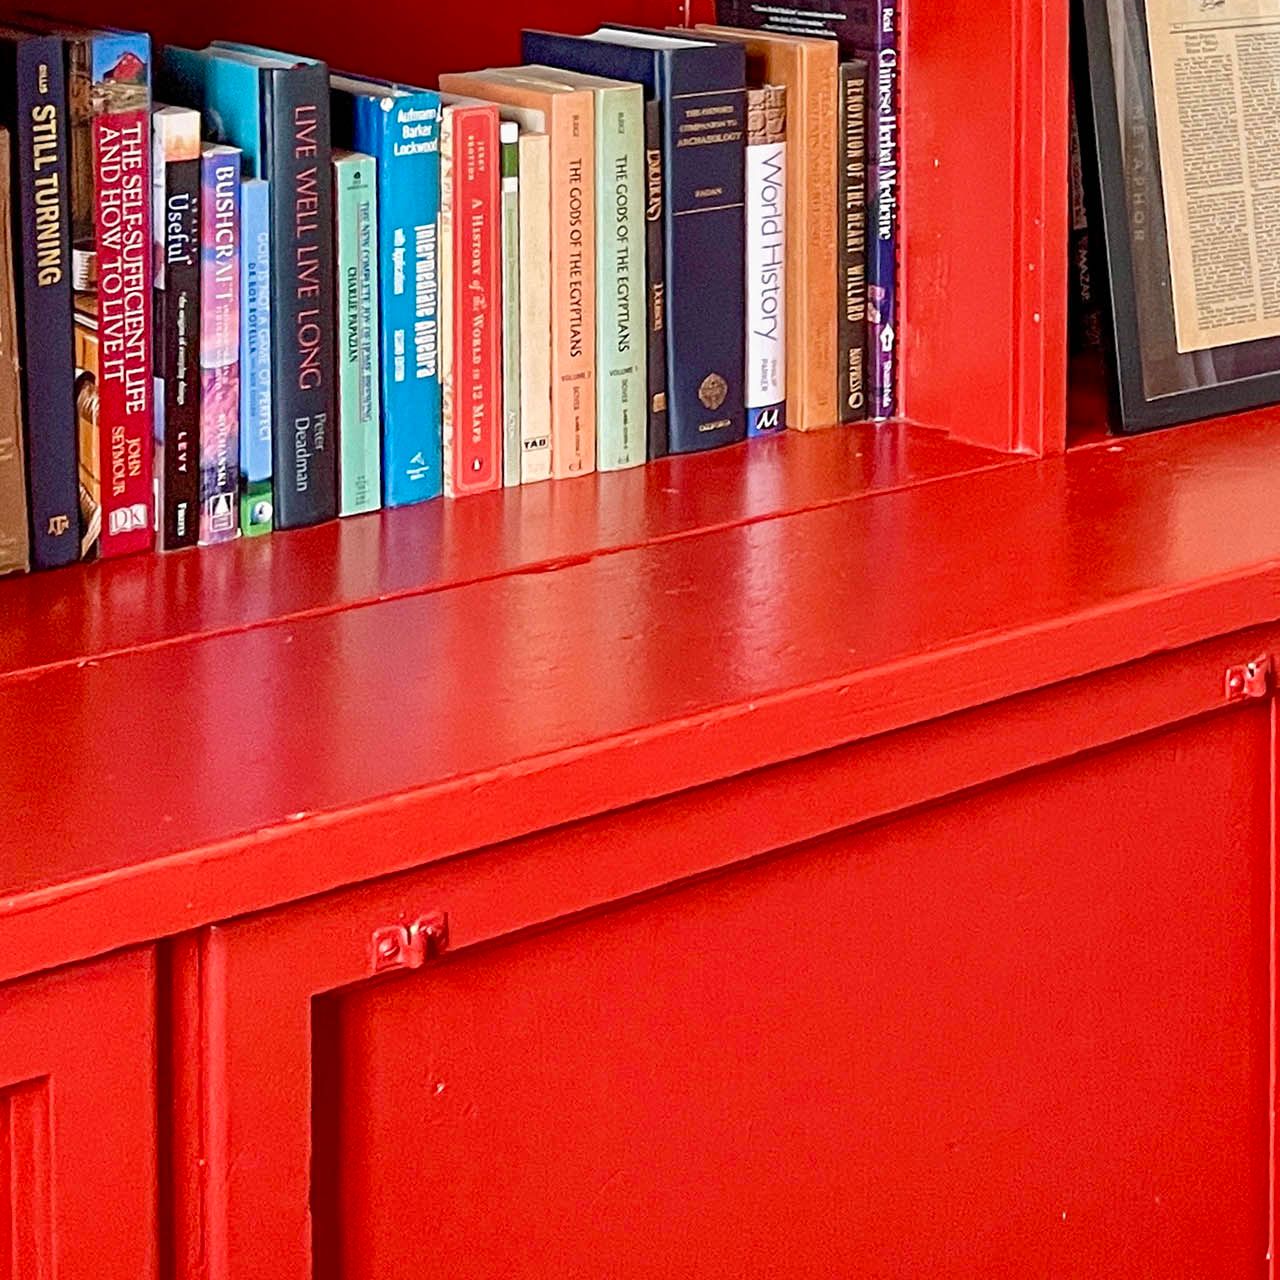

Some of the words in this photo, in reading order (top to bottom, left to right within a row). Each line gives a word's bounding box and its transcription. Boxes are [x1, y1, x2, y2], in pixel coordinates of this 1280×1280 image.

[32, 104, 56, 170] STILL
[99, 126, 122, 182] AND
[119, 122, 142, 170] THE
[294, 105, 317, 159] LIVE
[569, 157, 583, 185] THE
[615, 154, 629, 181] THE
[760, 150, 784, 236] World
[1133, 104, 1148, 242] METAPHOR
[35, 172, 61, 286] TURNING
[100, 188, 123, 250] HOW
[295, 166, 318, 238] WELL
[569, 187, 583, 226] GODS
[615, 183, 630, 222] GODS
[569, 229, 583, 251] OF
[615, 224, 630, 244] OF
[616, 245, 631, 273] THE
[102, 256, 123, 295] TO
[121, 173, 144, 363] SELF-SUFFICIENT
[296, 245, 319, 299] LIVE
[413, 223, 437, 318] Intermediate
[569, 252, 583, 279] THE
[752, 243, 784, 342] History
[103, 300, 124, 354] LIVE
[569, 280, 584, 358] EGYPTIANS
[616, 275, 631, 353] EGYPTIANS
[104, 355, 125, 383] IT
[298, 308, 322, 390] LONG
[415, 320, 438, 379] Algebra
[125, 365, 146, 415] LIFE
[126, 437, 141, 477] JOHN
[177, 431, 187, 473] LEVY
[294, 418, 311, 492] Deadman
[311, 412, 327, 452] Peter
[111, 425, 126, 497] SEYMOUR
